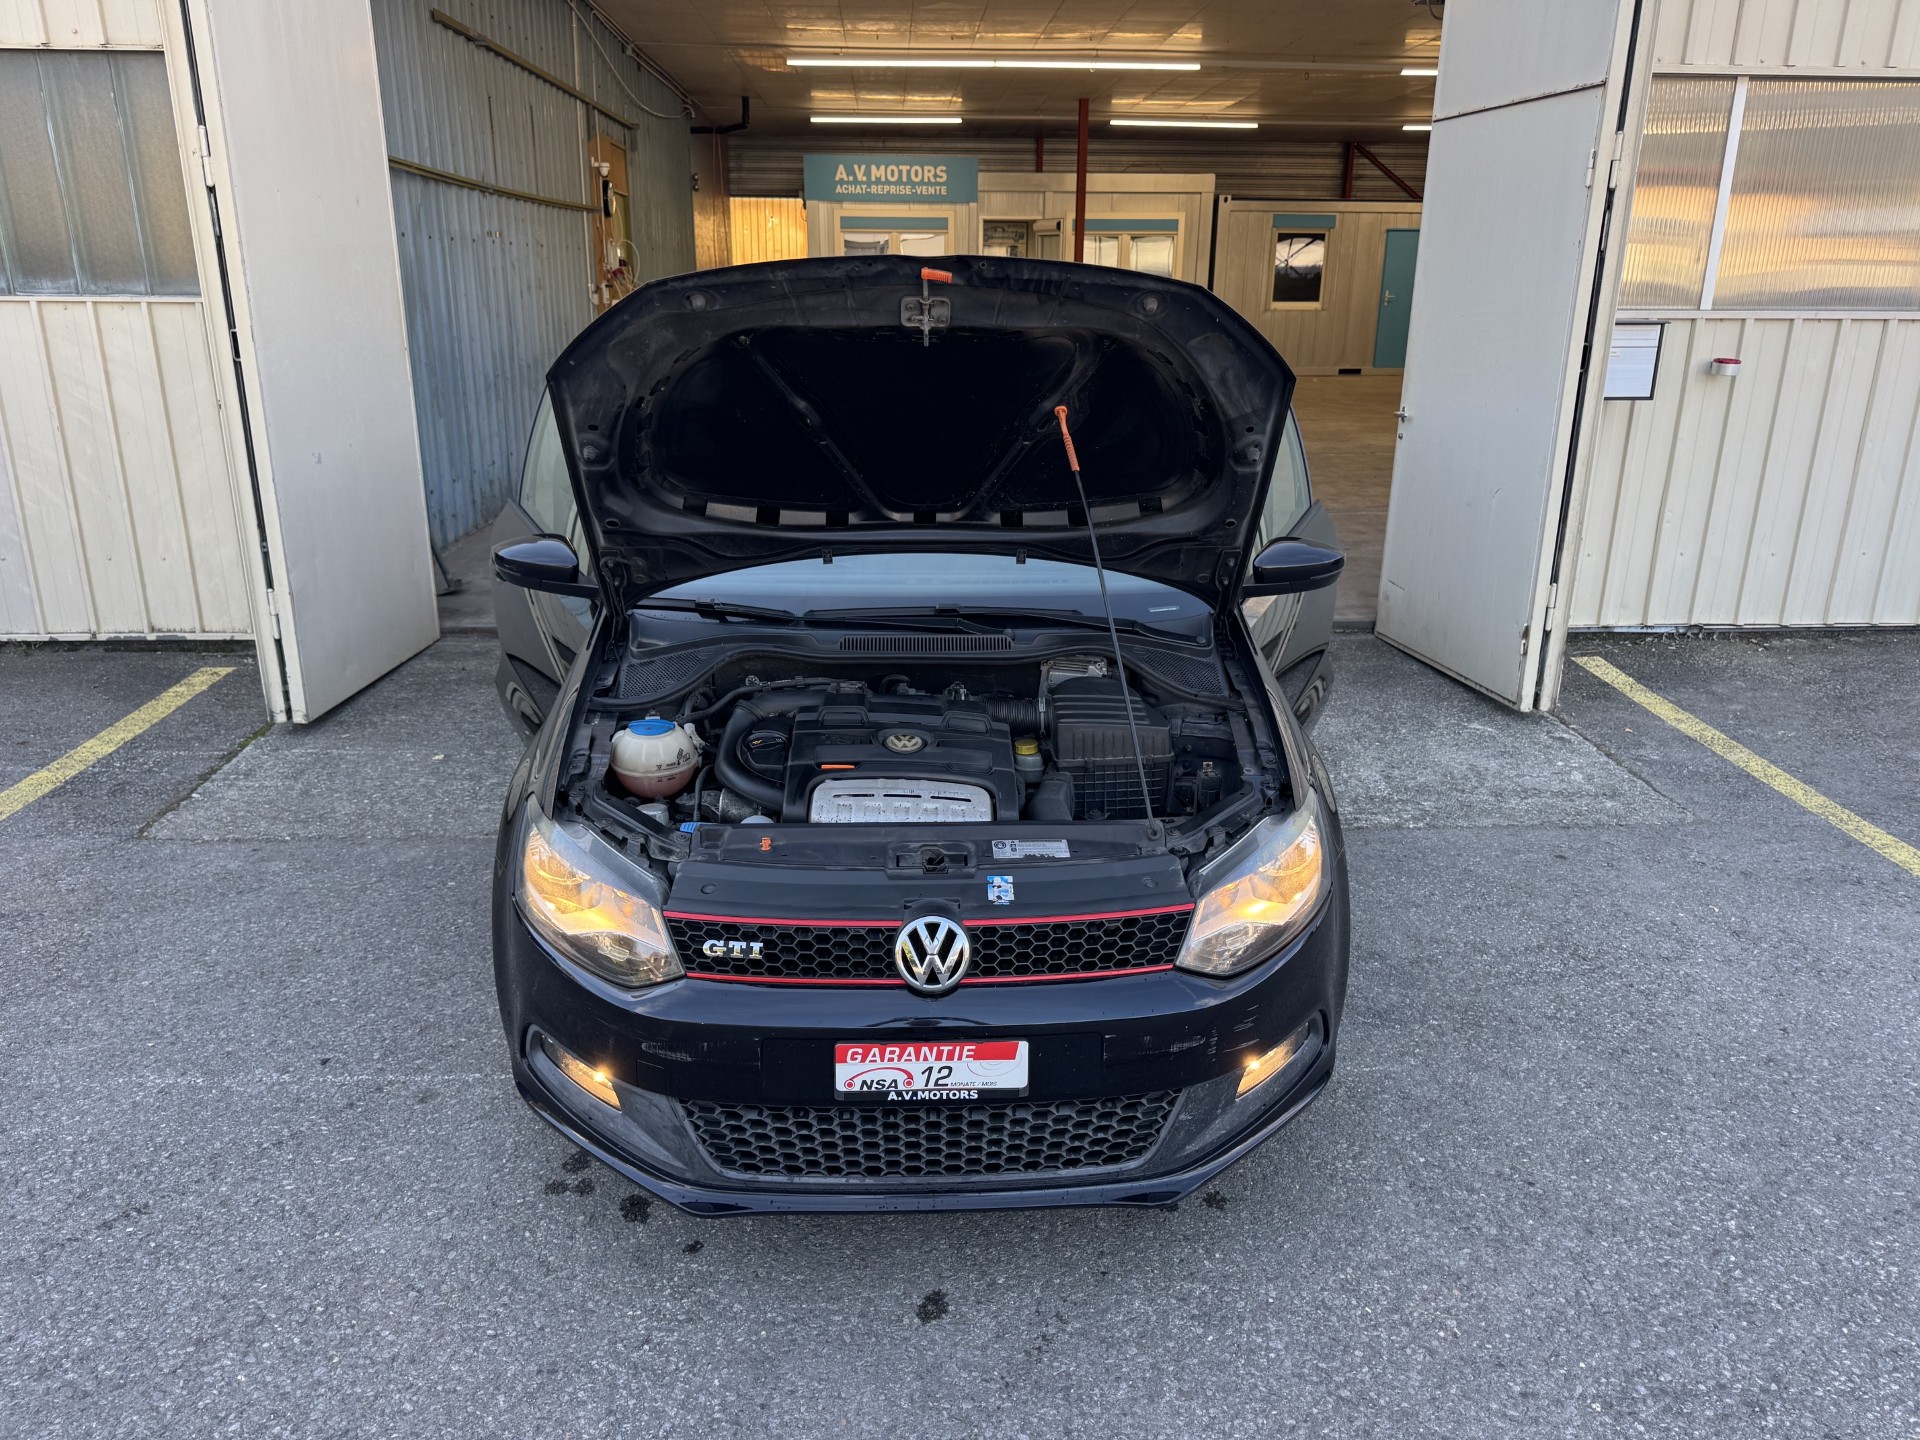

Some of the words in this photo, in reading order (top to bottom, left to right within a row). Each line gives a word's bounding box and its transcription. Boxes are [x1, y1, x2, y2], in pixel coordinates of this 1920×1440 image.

[870, 165, 948, 182] MOTORS
[835, 184, 948, 195] ACHAT-REPRISE-VENTE
[702, 939, 764, 959] GTI
[846, 1045, 976, 1064] GARANTIE
[859, 1078, 899, 1090] NSA
[921, 1065, 953, 1088] 12
[888, 1089, 979, 1100] A.V.MOTORS
